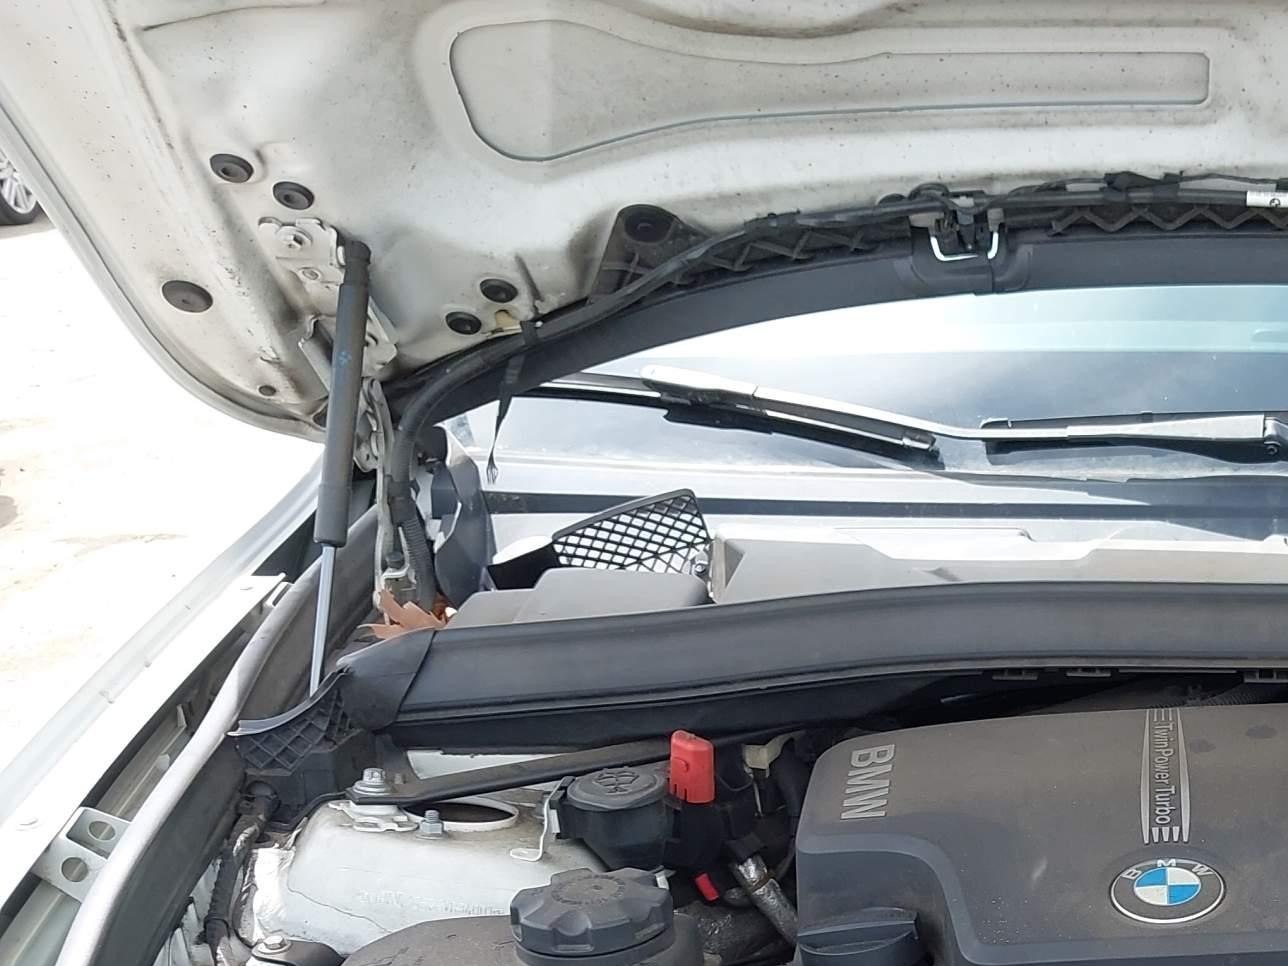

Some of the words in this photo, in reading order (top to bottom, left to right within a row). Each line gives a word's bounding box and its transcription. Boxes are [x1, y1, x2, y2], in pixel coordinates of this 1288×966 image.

[1153, 721, 1175, 785] TwinPower
[840, 743, 895, 819] BMW
[1154, 785, 1176, 825] Turbo
[1120, 858, 1218, 880] BMW
